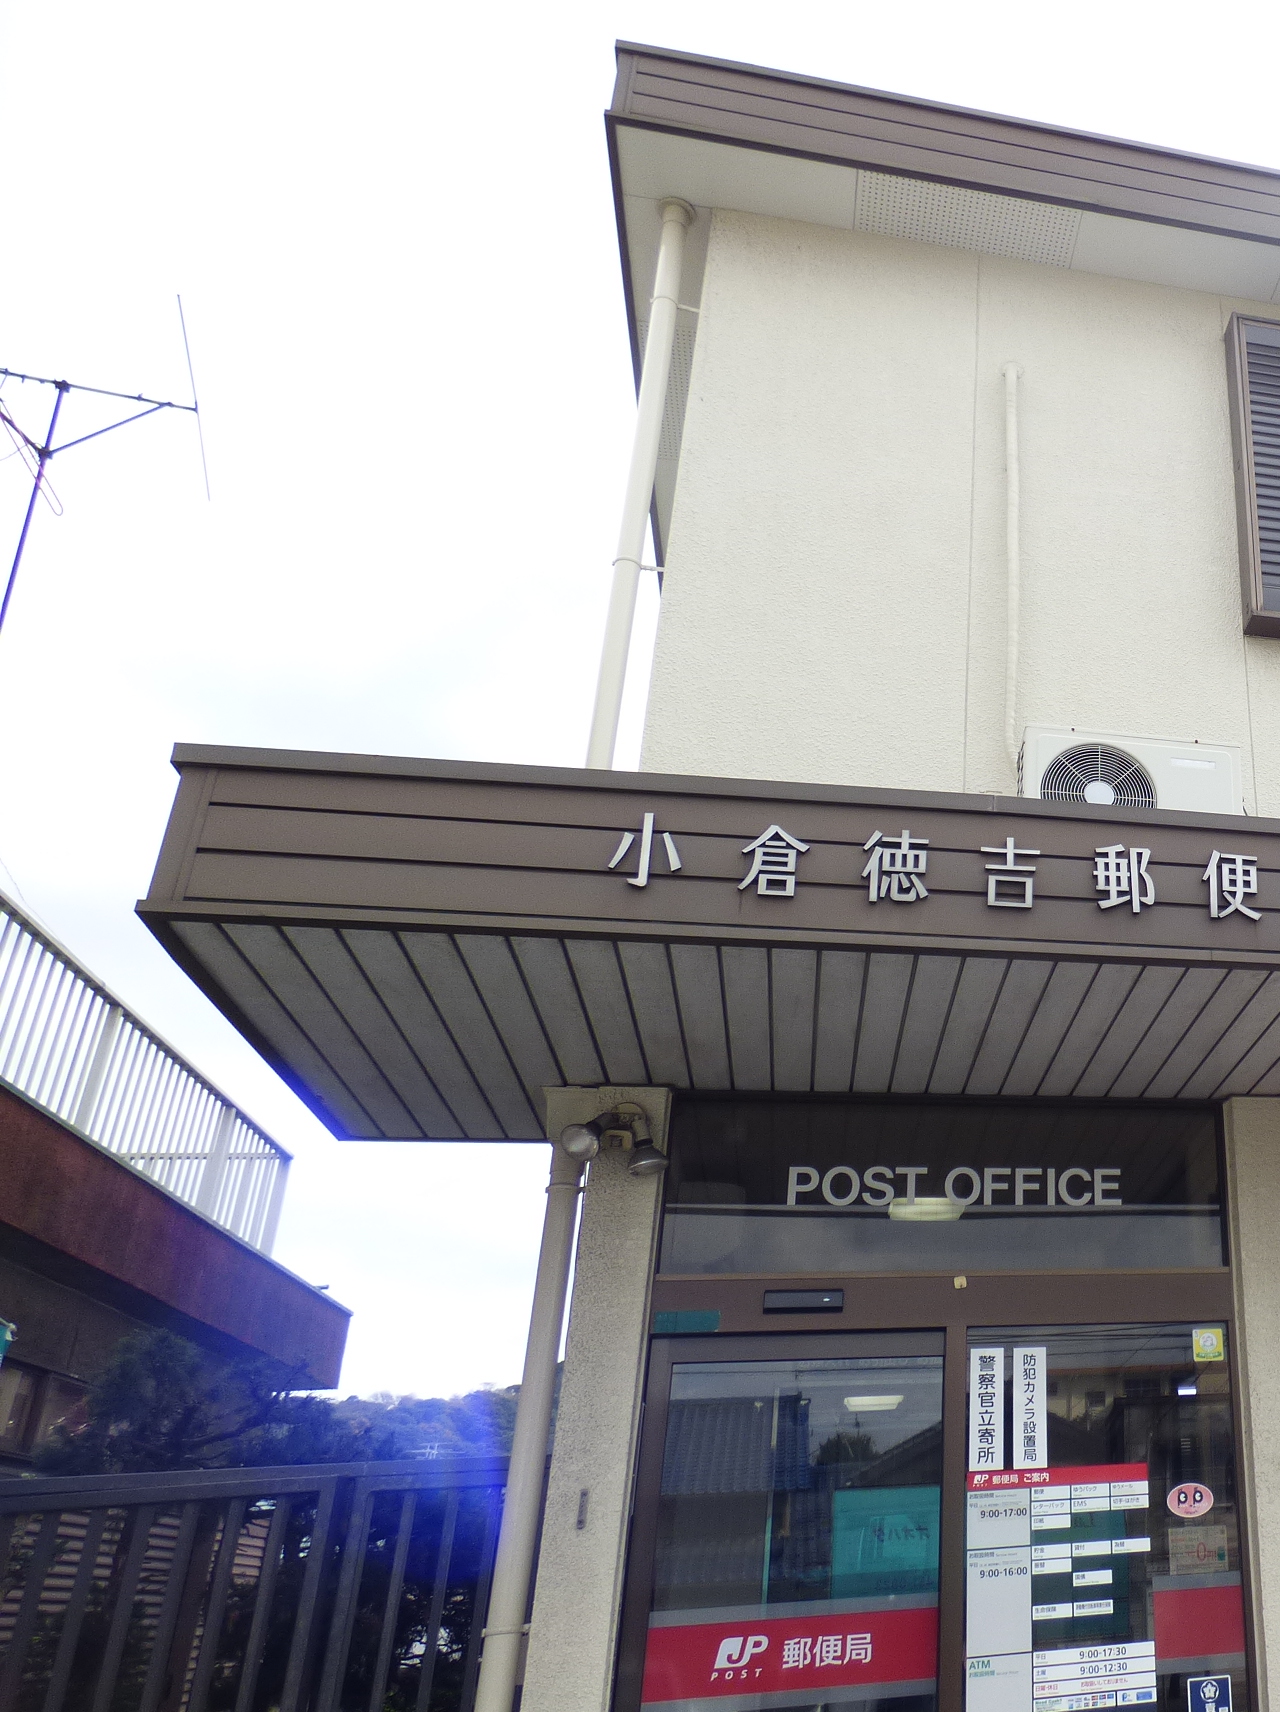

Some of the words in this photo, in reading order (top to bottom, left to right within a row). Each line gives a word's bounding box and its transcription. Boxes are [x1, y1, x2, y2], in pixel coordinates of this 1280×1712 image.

[786, 1166, 928, 1206] POST
[944, 1166, 1123, 1206] OFFICE
[977, 1354, 997, 1465] 警察官立寄所
[1022, 1353, 1037, 1462] 防犯カメラ設置局
[992, 1473, 1019, 1485] 郵便局
[1023, 1472, 1050, 1483] ご案内
[1073, 1485, 1097, 1493] ゆうパック
[1033, 1502, 1065, 1510] レターパック
[1073, 1499, 1087, 1507] EMS
[980, 1507, 1028, 1519] 9:00-17:00
[979, 1566, 1028, 1579] 9:00-16:00
[713, 1635, 769, 1669] JP
[782, 1632, 873, 1669] 郵便局
[1079, 1646, 1127, 1660] 9:00-17:30
[968, 1659, 991, 1671] ATM
[1079, 1662, 1128, 1676] 9:00-12:30
[710, 1668, 762, 1682] POST
